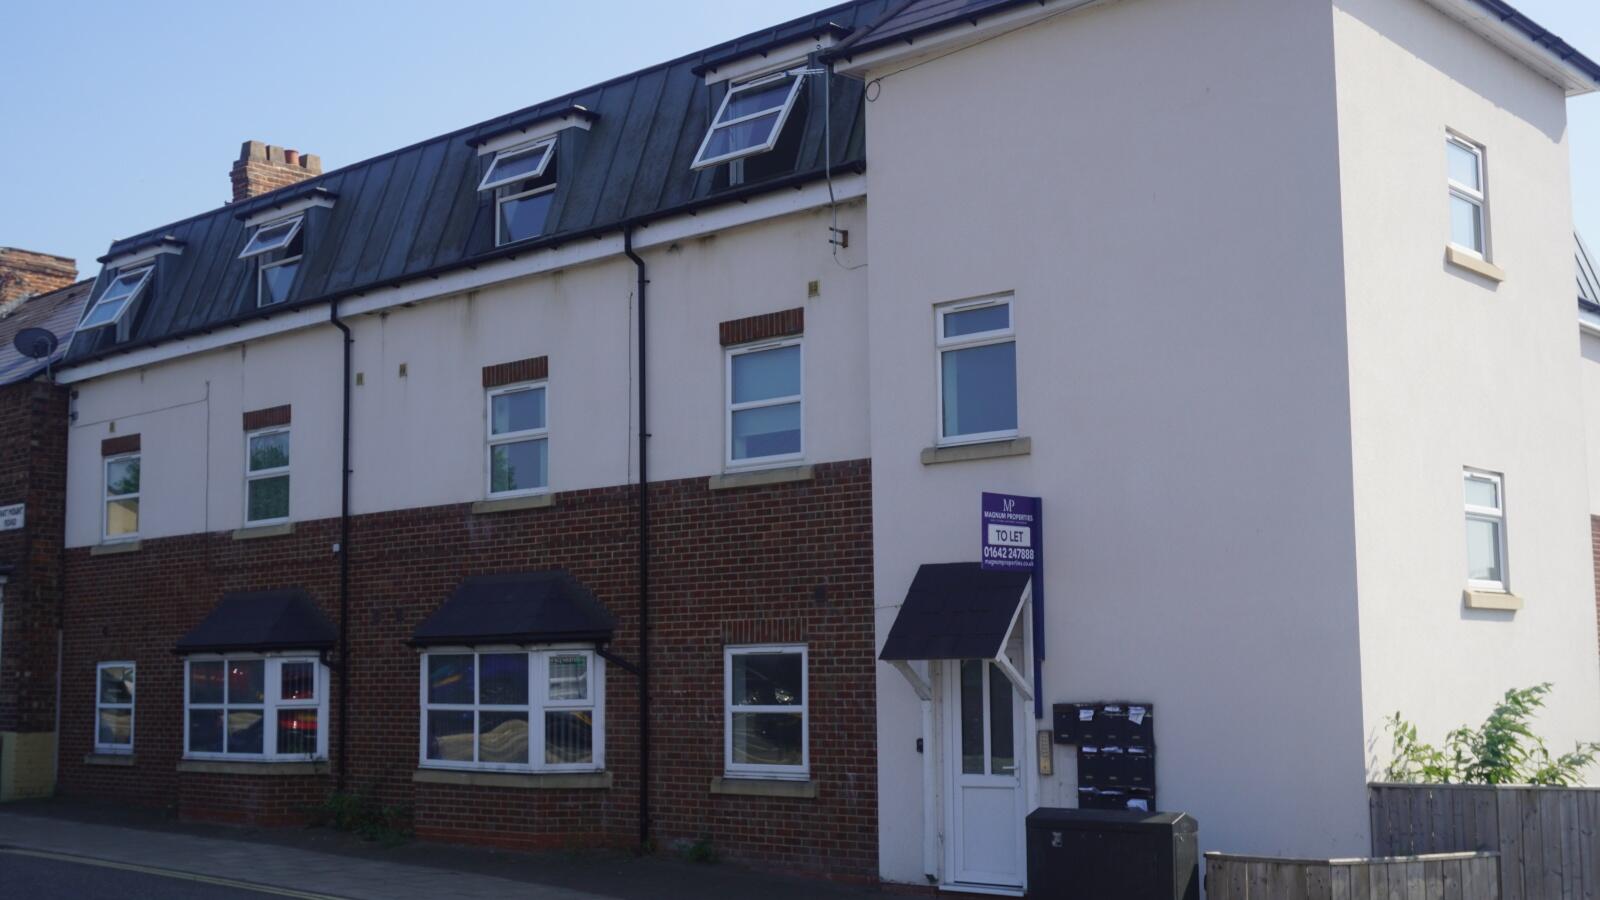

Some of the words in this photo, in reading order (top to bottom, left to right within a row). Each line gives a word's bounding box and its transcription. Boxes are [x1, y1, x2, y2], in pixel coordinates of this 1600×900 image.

[984, 511, 1007, 519] MAGNUM
[1007, 512, 1033, 522] PROPERTIES
[996, 530, 1008, 542] TO
[1009, 531, 1024, 543] LET
[984, 546, 1007, 559] 01642
[1008, 549, 1034, 560] 247888
